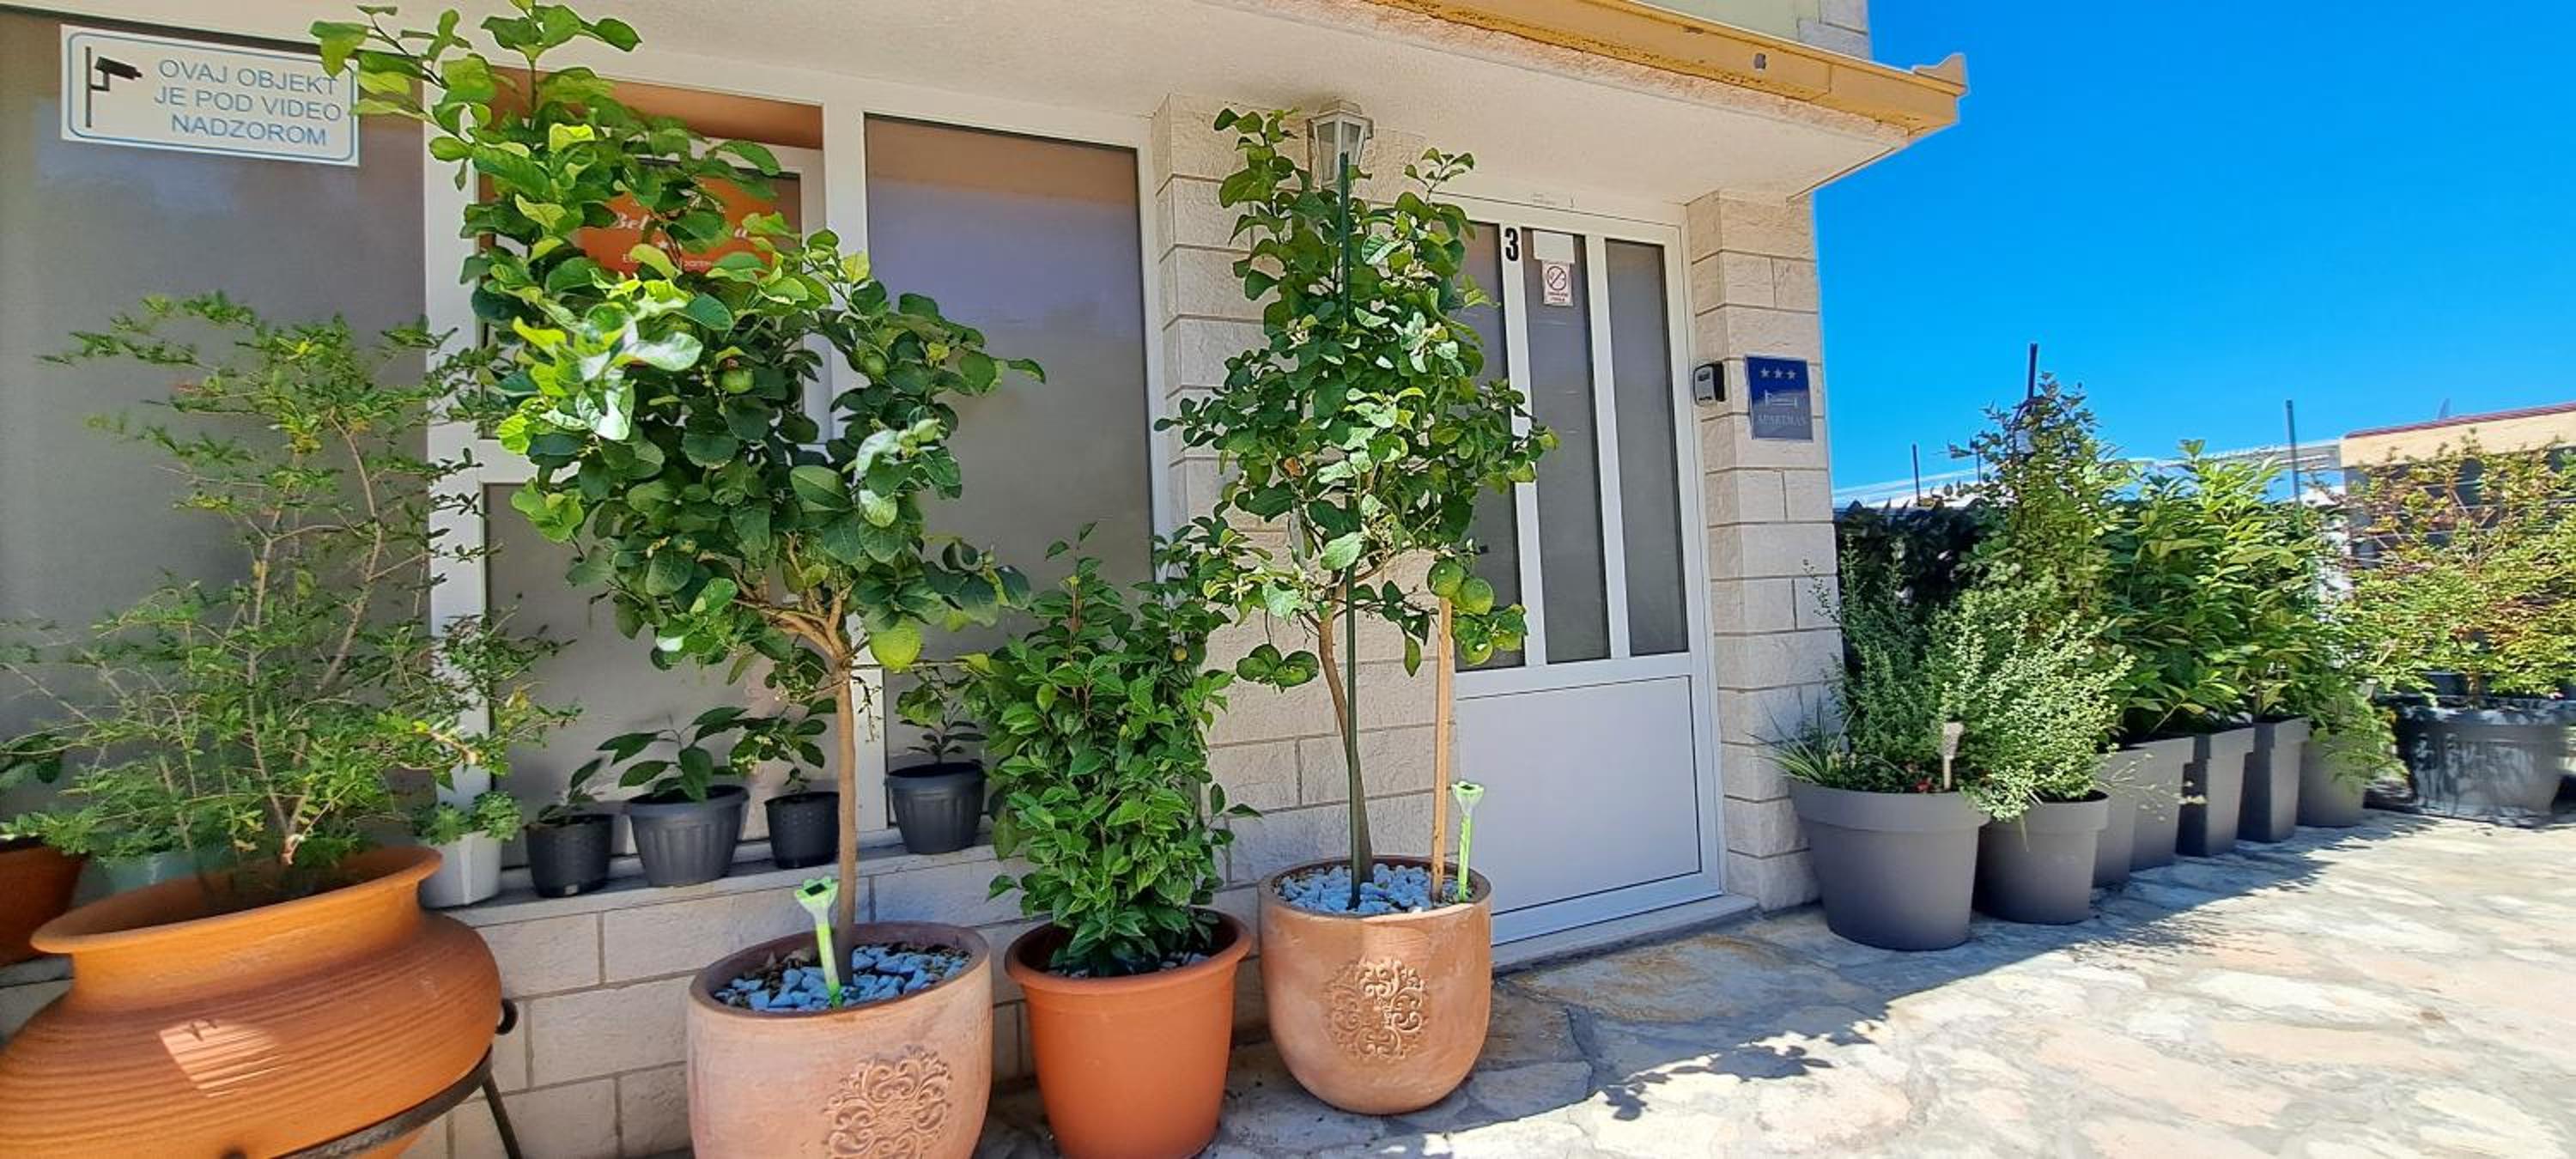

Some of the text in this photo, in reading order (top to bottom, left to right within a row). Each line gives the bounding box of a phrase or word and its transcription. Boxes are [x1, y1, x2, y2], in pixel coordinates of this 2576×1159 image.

[158, 59, 337, 96] OVAJ OBJEKT
[155, 87, 342, 122] JE POD VIDEO
[171, 114, 326, 145] NADZOROM
[1504, 228, 1519, 262] 3
